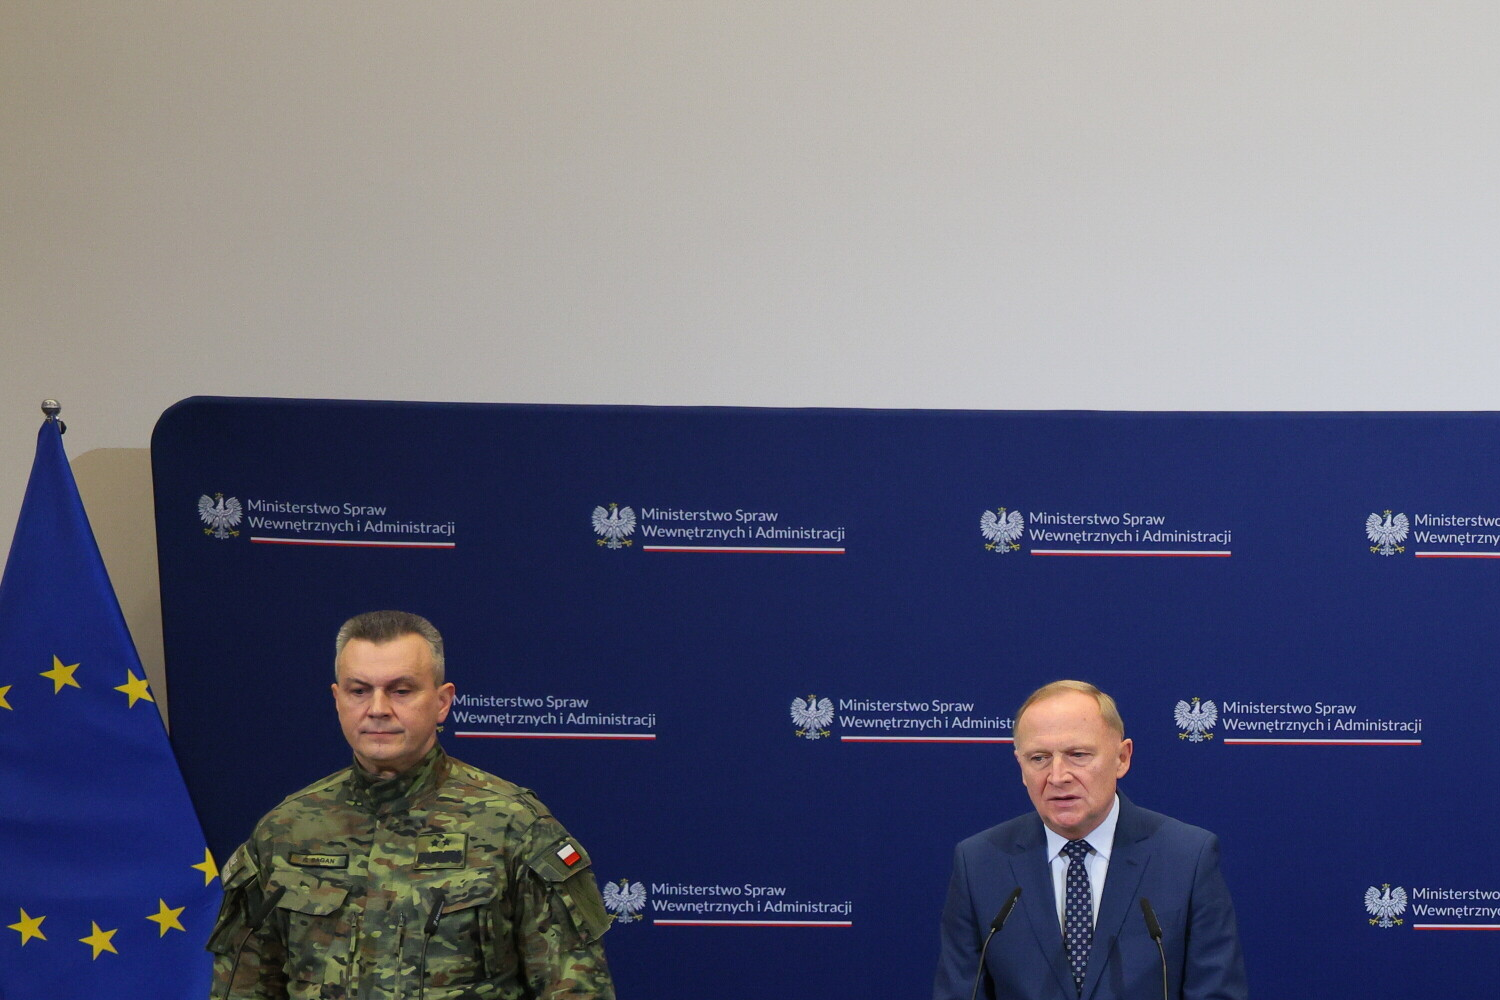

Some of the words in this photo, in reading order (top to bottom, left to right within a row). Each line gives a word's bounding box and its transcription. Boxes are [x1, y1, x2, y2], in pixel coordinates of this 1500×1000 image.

[247, 498, 341, 515] Ministerstwo
[343, 502, 387, 518] Spraw
[641, 507, 733, 522] Ministerstwo
[735, 508, 779, 524] Spraw
[247, 515, 354, 534] Wewnętrznych
[363, 520, 455, 537] Administracji
[1029, 511, 1120, 525] Ministerstwo
[1122, 512, 1166, 528] Spraw
[641, 524, 746, 541] Wewnętrznych
[754, 526, 845, 543] Administracji
[1028, 528, 1133, 545] Wewnętrznych
[1141, 529, 1232, 546] Administracji
[453, 693, 544, 708] Ministerstwo
[546, 695, 589, 711] Spraw
[839, 698, 930, 712] Ministerstwo
[931, 699, 975, 715] Spraw
[1223, 701, 1313, 714] Ministerstwo
[1314, 701, 1357, 717] Spraw
[452, 710, 557, 727] Wewnętrznych
[565, 712, 656, 729] Administracji
[838, 715, 942, 731] Wewnętrznych
[951, 716, 1016, 729] Administr
[1222, 717, 1325, 734] Wewnętrznych
[1333, 718, 1422, 734] Administracji
[651, 882, 742, 896] Ministerstwo
[743, 883, 787, 899] Spraw
[1412, 887, 1500, 900] Ministerstwo
[651, 899, 754, 915] Wewnętrznych
[763, 900, 852, 916] Administracji
